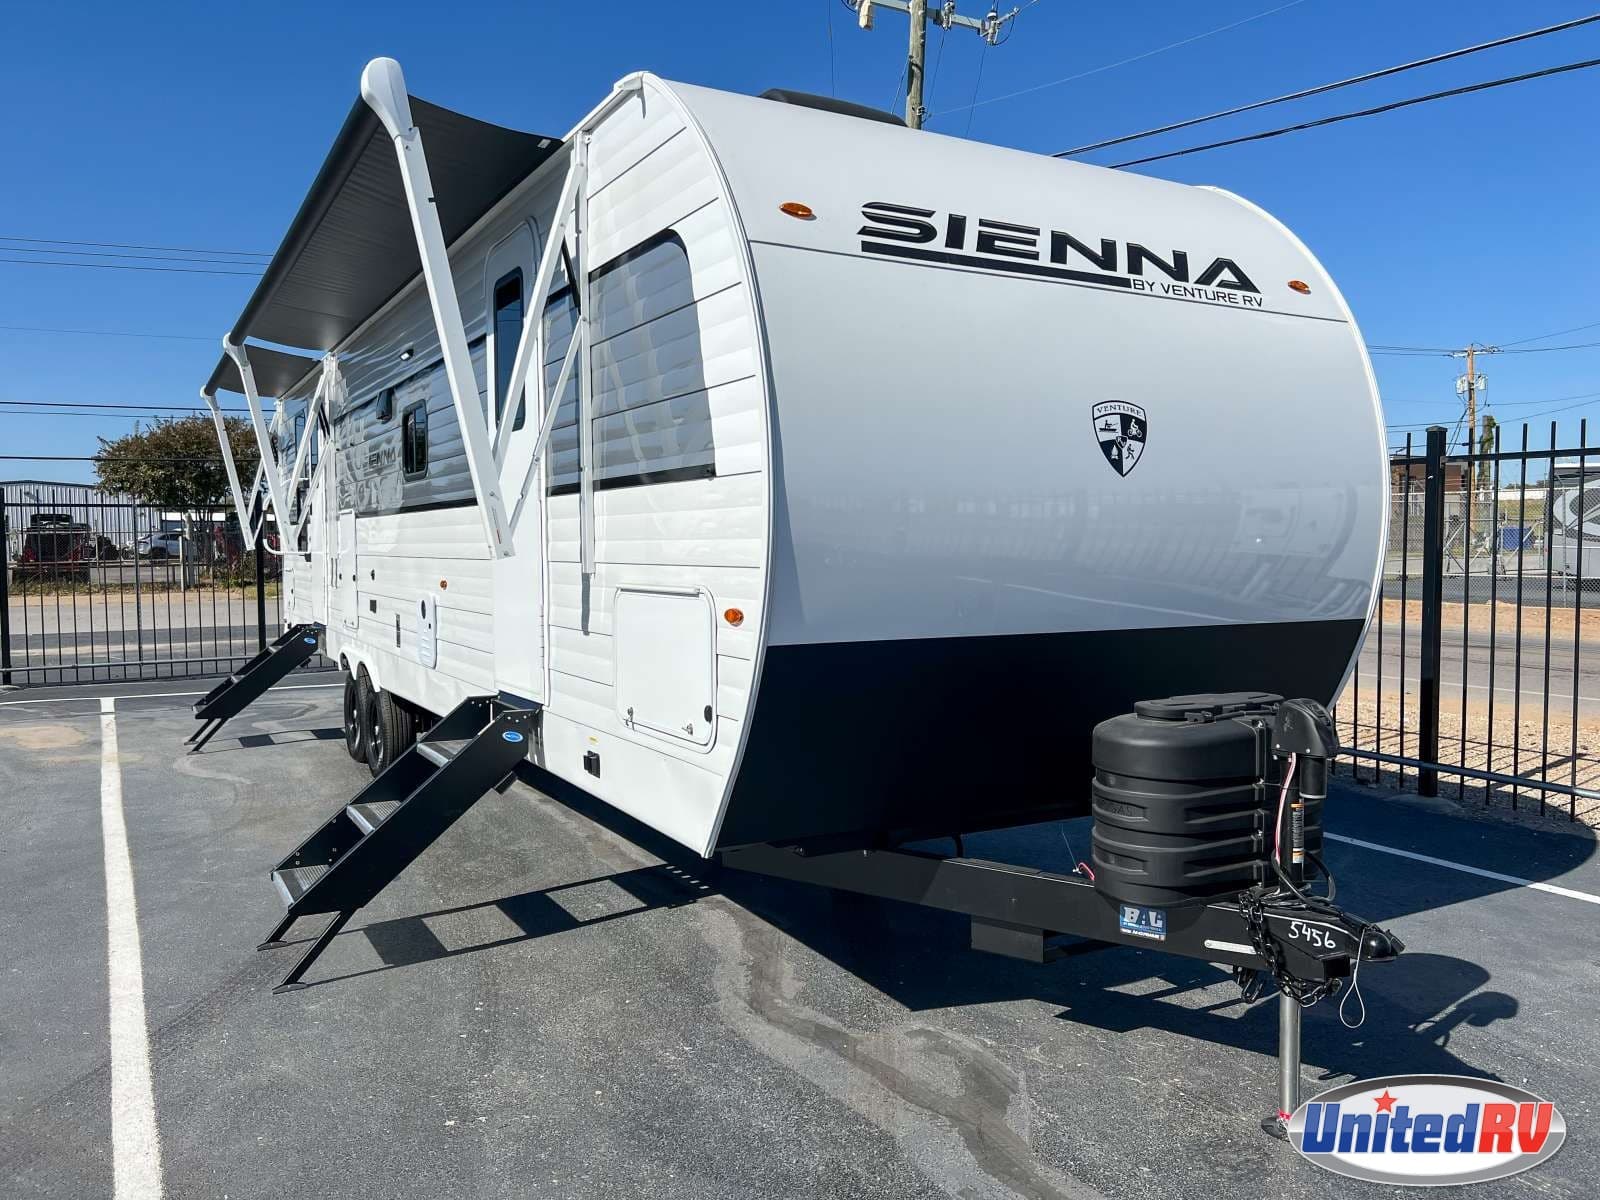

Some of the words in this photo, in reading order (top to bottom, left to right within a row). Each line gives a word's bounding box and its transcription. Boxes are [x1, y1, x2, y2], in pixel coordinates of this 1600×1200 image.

[857, 201, 1262, 294] SIENNA
[1132, 278, 1155, 292] BY
[1160, 282, 1239, 304] VENTURE
[1242, 295, 1262, 307] RV
[1097, 404, 1142, 416] VENTURE
[1288, 921, 1336, 949] 5456
